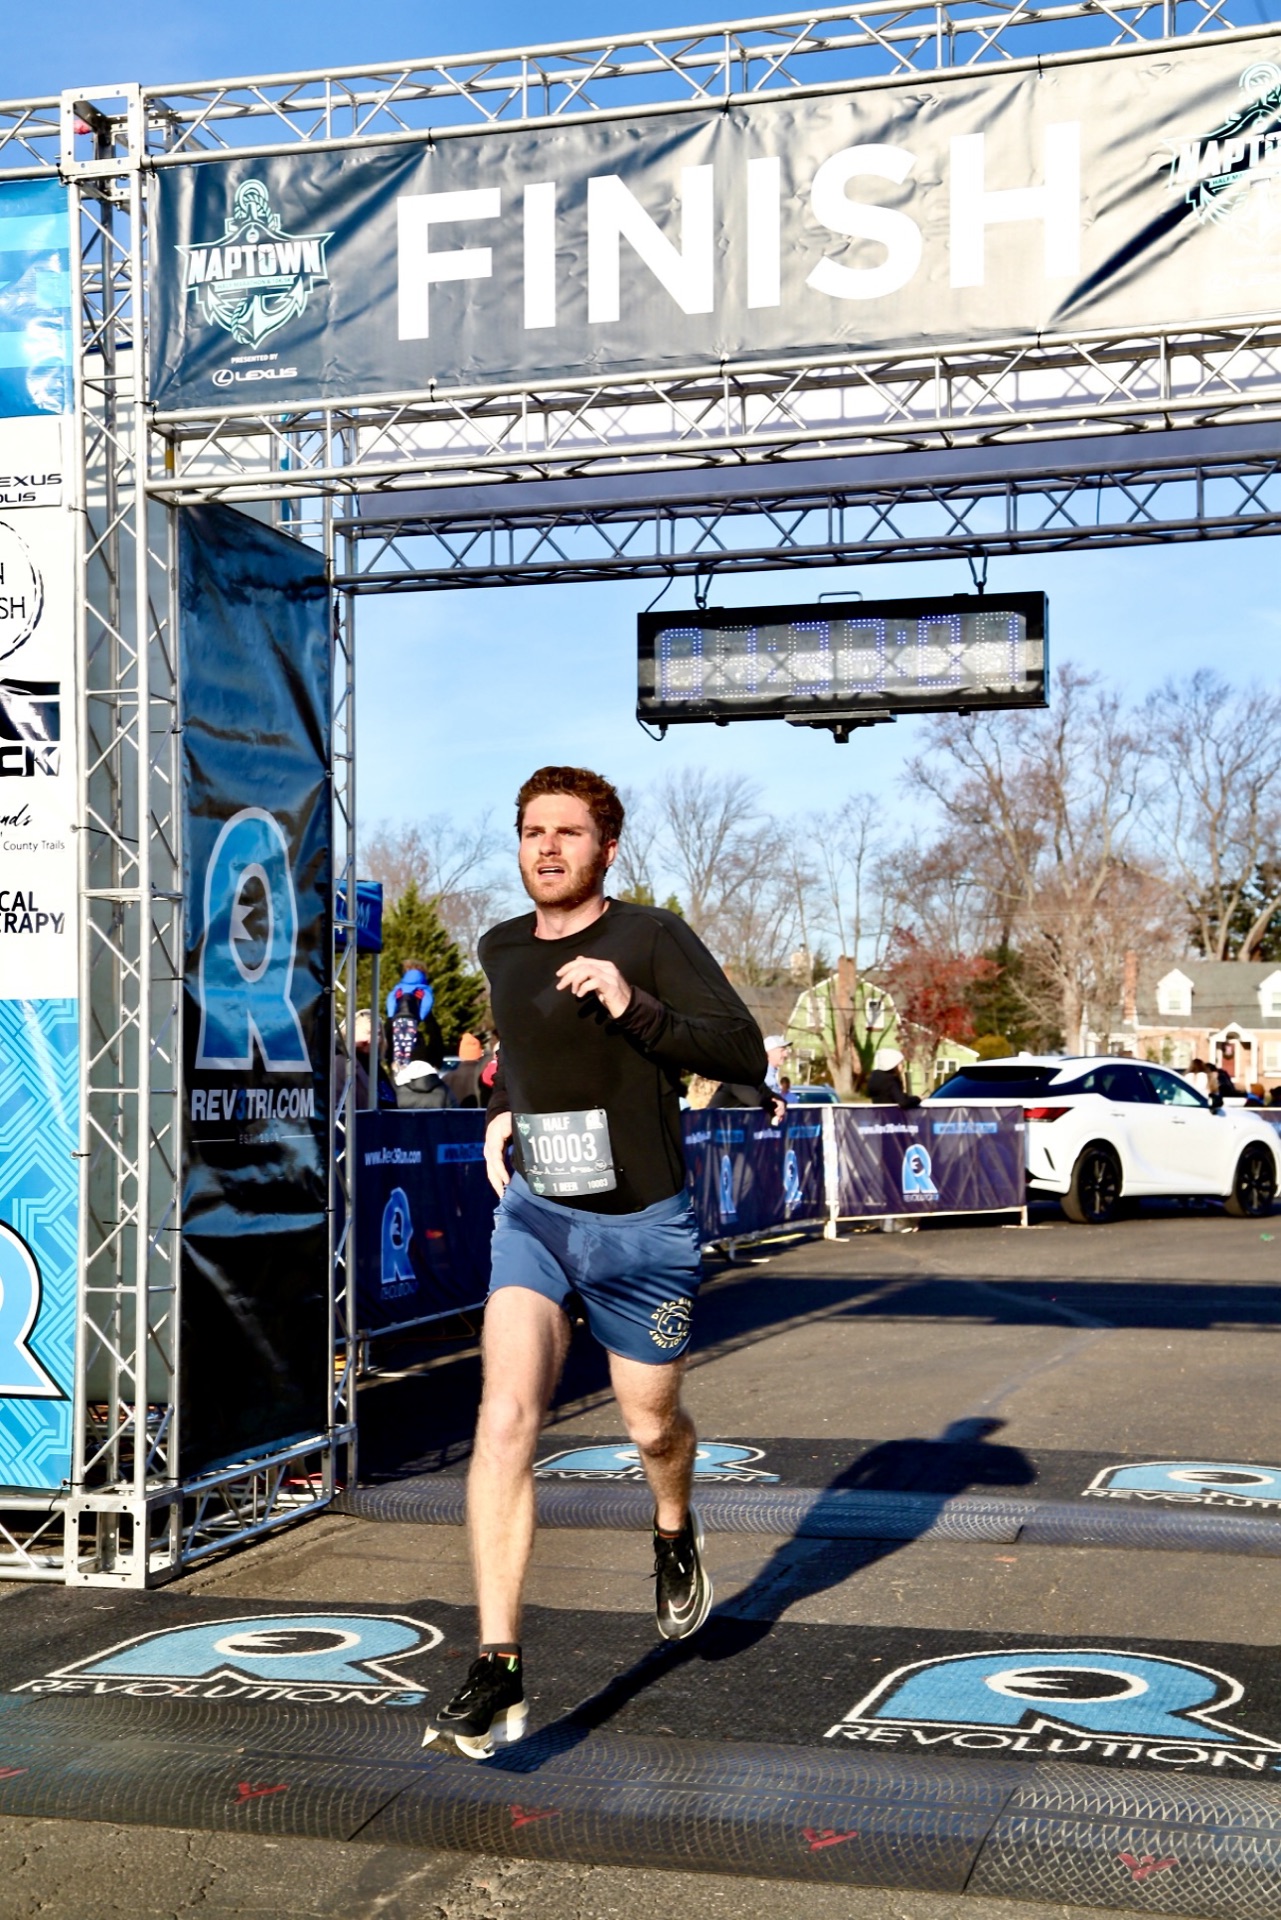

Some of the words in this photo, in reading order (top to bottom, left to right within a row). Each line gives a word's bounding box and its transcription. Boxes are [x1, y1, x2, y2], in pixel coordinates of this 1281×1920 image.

[398, 121, 1081, 341] FINISH
[188, 240, 321, 285] NAPTOWN
[231, 354, 268, 364] PRESENTED
[269, 353, 278, 361] BY
[235, 367, 298, 381] LEXUS
[0, 492, 36, 502] LIS
[3, 841, 38, 852] County
[41, 840, 65, 850] Trails
[0, 912, 64, 934] RAPY
[191, 1088, 315, 1121] REV3TRI.COM
[542, 1116, 570, 1131] HALF
[528, 1132, 597, 1164] 10003
[587, 1178, 608, 1189] 10003
[823, 1723, 1281, 1772] REVOLUTION
